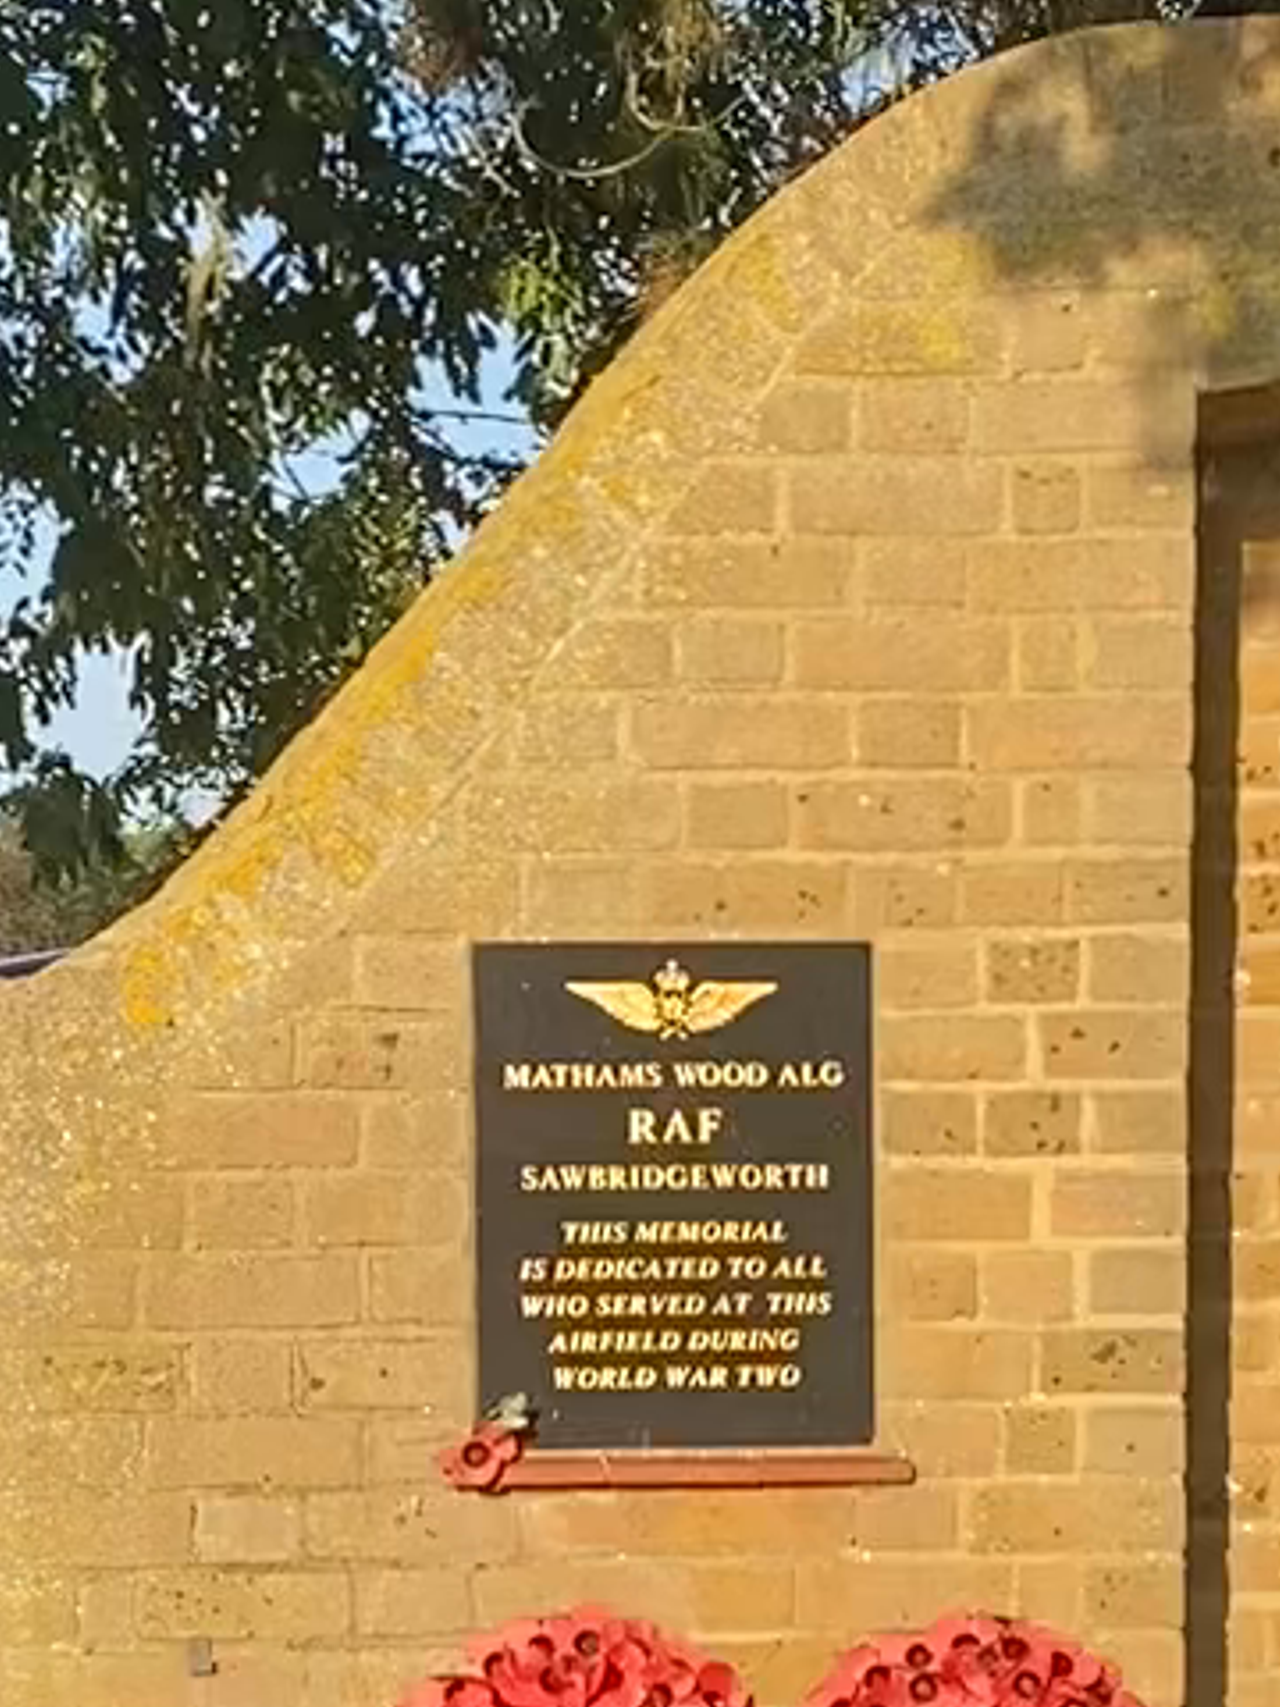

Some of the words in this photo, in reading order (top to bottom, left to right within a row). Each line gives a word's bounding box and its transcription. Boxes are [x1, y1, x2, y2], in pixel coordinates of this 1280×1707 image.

[503, 1063, 663, 1090] MATHAMS
[673, 1062, 769, 1089] WOOD
[777, 1061, 845, 1088] ALG
[628, 1107, 723, 1145] RAF
[520, 1163, 830, 1192] SAWBRIDGEWORTH
[560, 1221, 628, 1244] THIS
[634, 1220, 788, 1243] MEMORIAL
[520, 1257, 547, 1282] IS
[553, 1256, 721, 1282] DEDICATED
[727, 1255, 767, 1280] TO
[772, 1255, 828, 1279] ALL
[520, 1293, 590, 1318] WHO
[595, 1293, 706, 1318] SERVED
[711, 1292, 754, 1316] AT
[766, 1291, 831, 1315] THIS
[547, 1329, 682, 1355] AIRFIELD
[686, 1327, 800, 1353] DURING
[552, 1365, 658, 1390] WORLD
[665, 1365, 729, 1389] WAR
[735, 1363, 802, 1388] TWO
